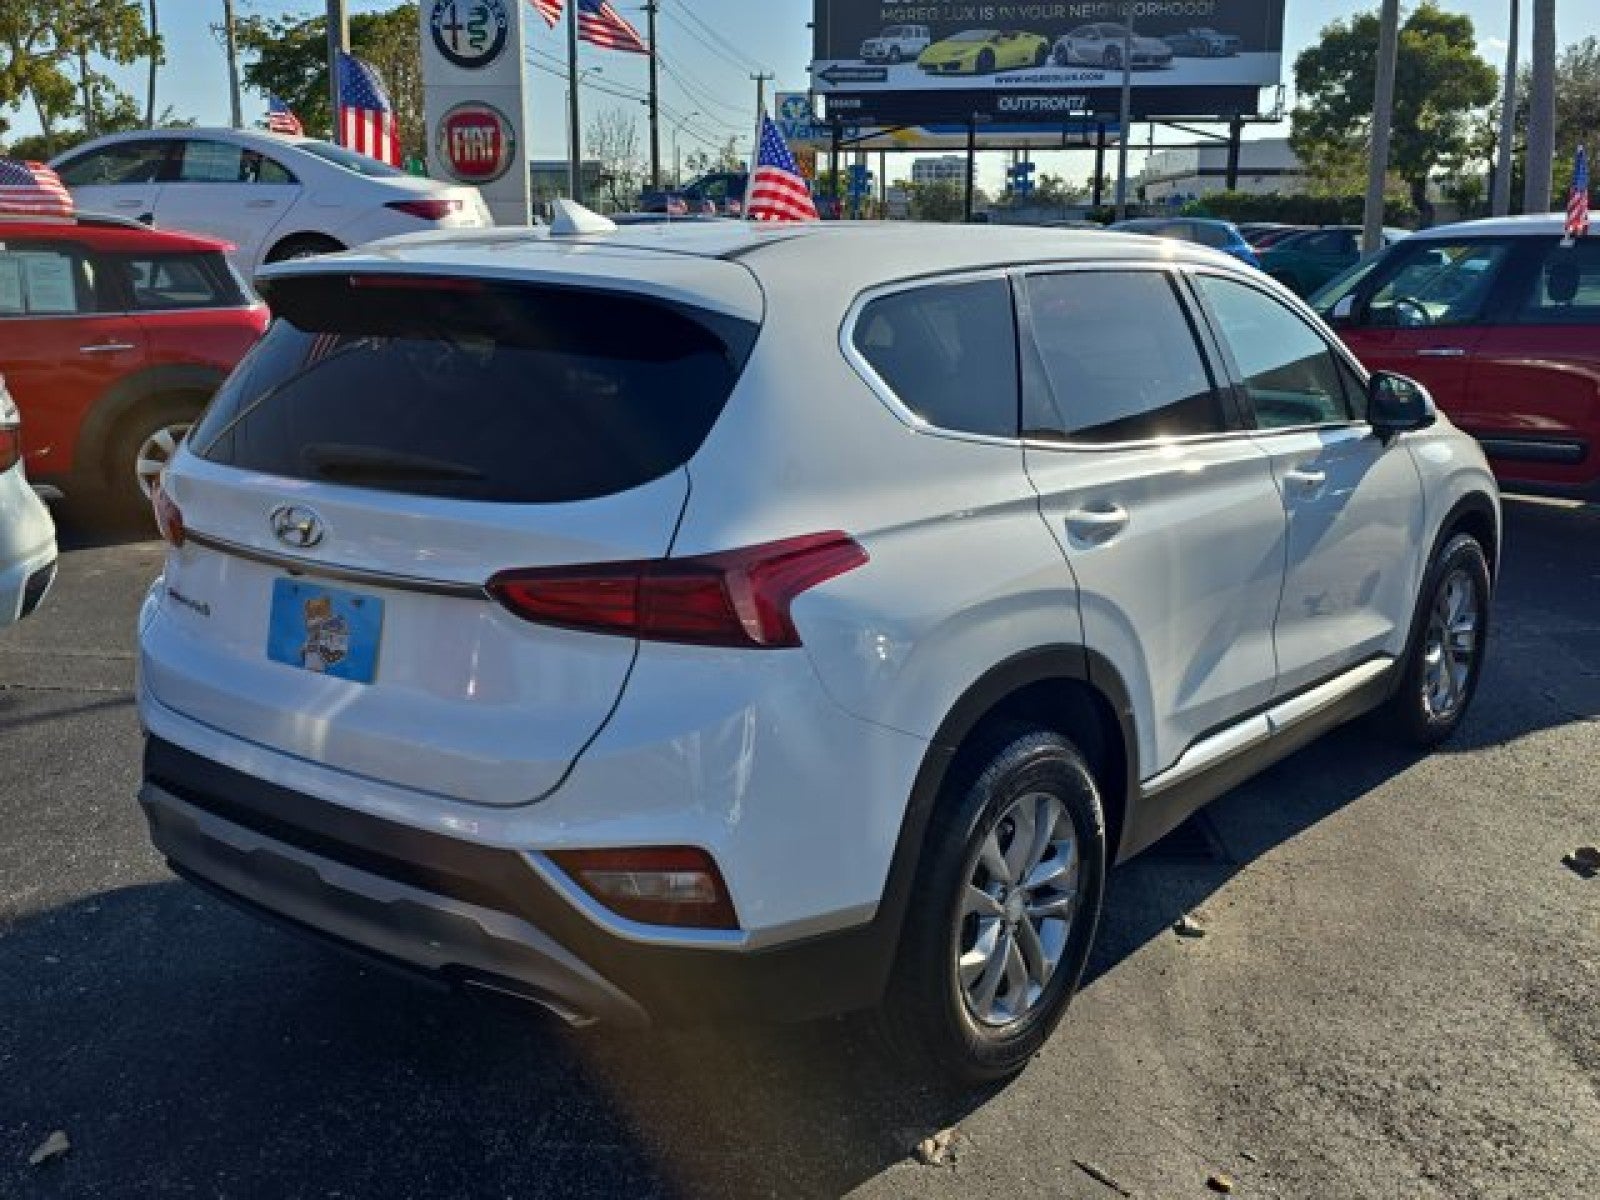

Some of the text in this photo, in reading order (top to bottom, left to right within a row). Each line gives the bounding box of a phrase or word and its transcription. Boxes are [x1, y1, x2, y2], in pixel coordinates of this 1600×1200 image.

[979, 6, 995, 20] IS
[1018, 5, 1066, 19] YOUR
[453, 127, 495, 161] FIAT
